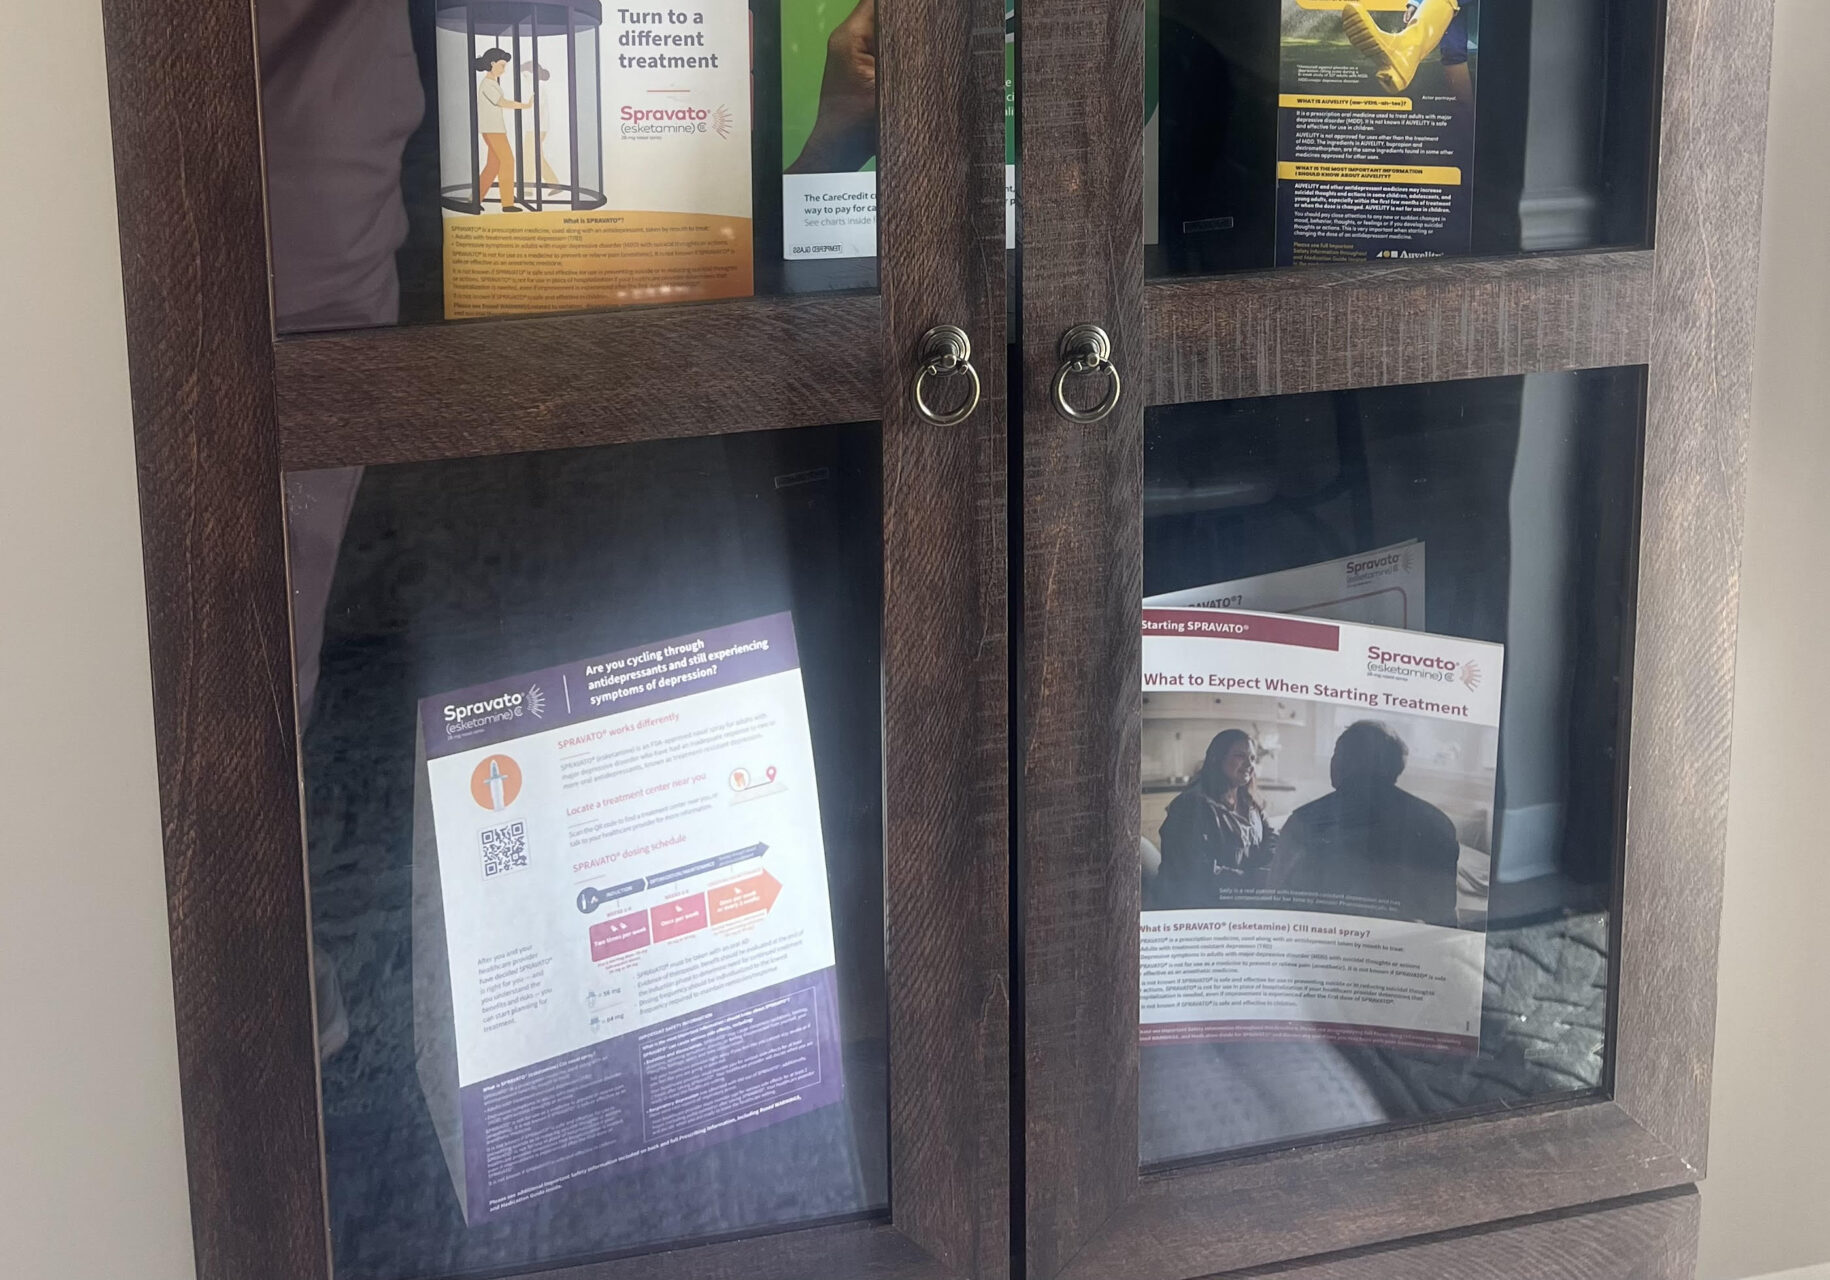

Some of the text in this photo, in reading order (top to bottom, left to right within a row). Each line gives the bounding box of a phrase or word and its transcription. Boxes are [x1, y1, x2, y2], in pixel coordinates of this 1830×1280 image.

[617, 8, 704, 25] Turn to a
[618, 30, 705, 47] different
[619, 52, 719, 69] treatment
[620, 105, 707, 124] Spravato
[621, 122, 696, 135] (esketamine)
[822, 192, 868, 201] CareCredit
[835, 206, 851, 215] pay
[853, 204, 865, 212] for
[821, 218, 845, 226] charts
[1346, 553, 1400, 575] Spravato
[1142, 620, 1184, 632] Starting
[585, 639, 704, 677] Are you cycling through
[587, 638, 769, 690] antidepressants and still experiencing
[1368, 646, 1456, 671] Spravato
[1367, 660, 1443, 682] (esketamine)
[590, 665, 718, 706] symptoms of depression?
[1144, 673, 1469, 717] What to Expect When Starting Treatment
[443, 694, 523, 722] Spravato
[446, 709, 514, 735] (esketamine)
[609, 724, 636, 737] works
[637, 712, 680, 729] differently
[566, 802, 594, 816] Locate
[602, 789, 644, 806] treatment
[645, 782, 670, 795] center
[672, 778, 690, 788] near
[691, 773, 706, 785] you
[622, 845, 650, 860] dosing
[651, 834, 687, 850] schedule
[1163, 924, 1171, 932] is
[1229, 922, 1290, 933] (esketamine)
[1311, 925, 1336, 934] nasal
[1339, 927, 1370, 938] spray?
